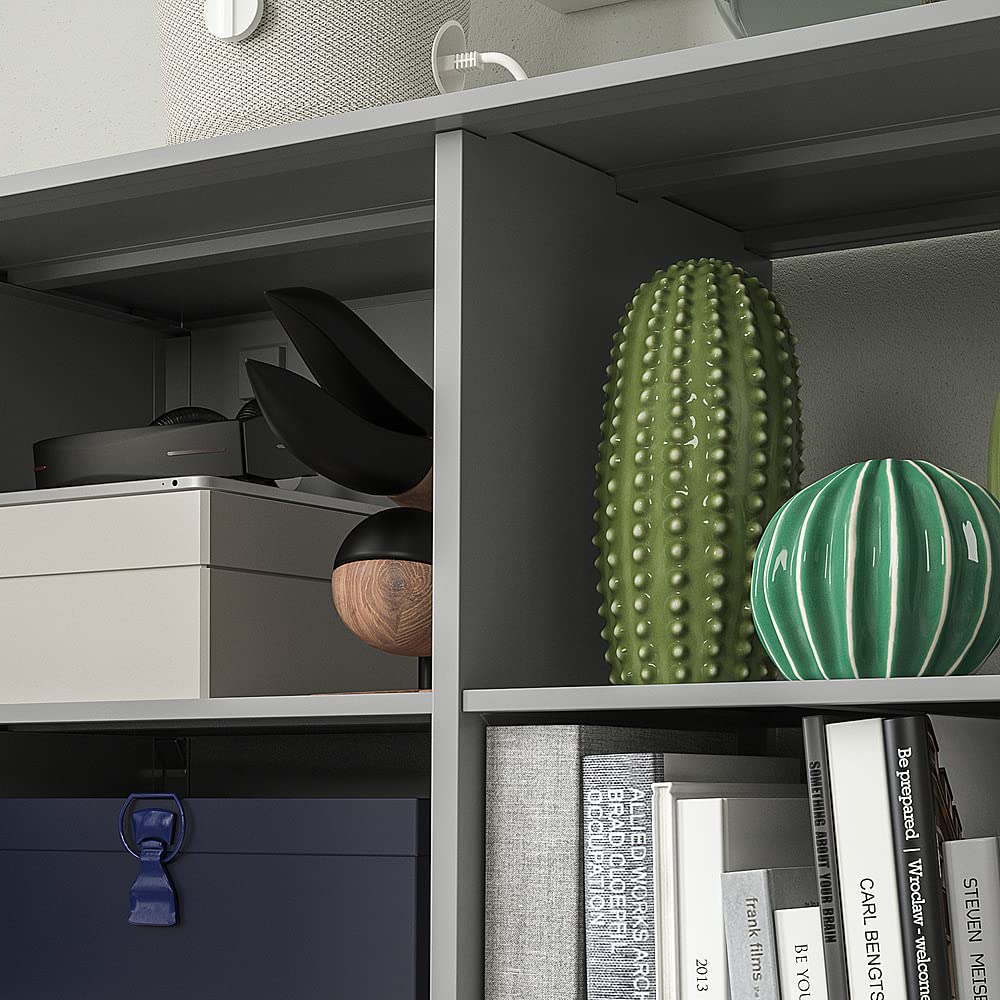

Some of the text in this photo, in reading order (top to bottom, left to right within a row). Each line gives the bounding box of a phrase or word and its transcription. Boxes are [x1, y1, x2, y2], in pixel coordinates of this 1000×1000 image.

[897, 747, 912, 768] Be
[607, 788, 624, 846] BRAD
[630, 788, 648, 861] ALLIED
[896, 770, 920, 840] prepared
[587, 788, 605, 926] OCCUPATION
[809, 761, 837, 943] SOMETHING ABOUT YOUR BRAIN
[631, 866, 650, 942] WORKS
[860, 877, 876, 926] CARL
[908, 858, 926, 926] Wroclaw
[963, 877, 983, 943] STEVEN
[745, 896, 764, 981] frank films
[794, 944, 808, 963] BE
[695, 958, 708, 992] 2013
